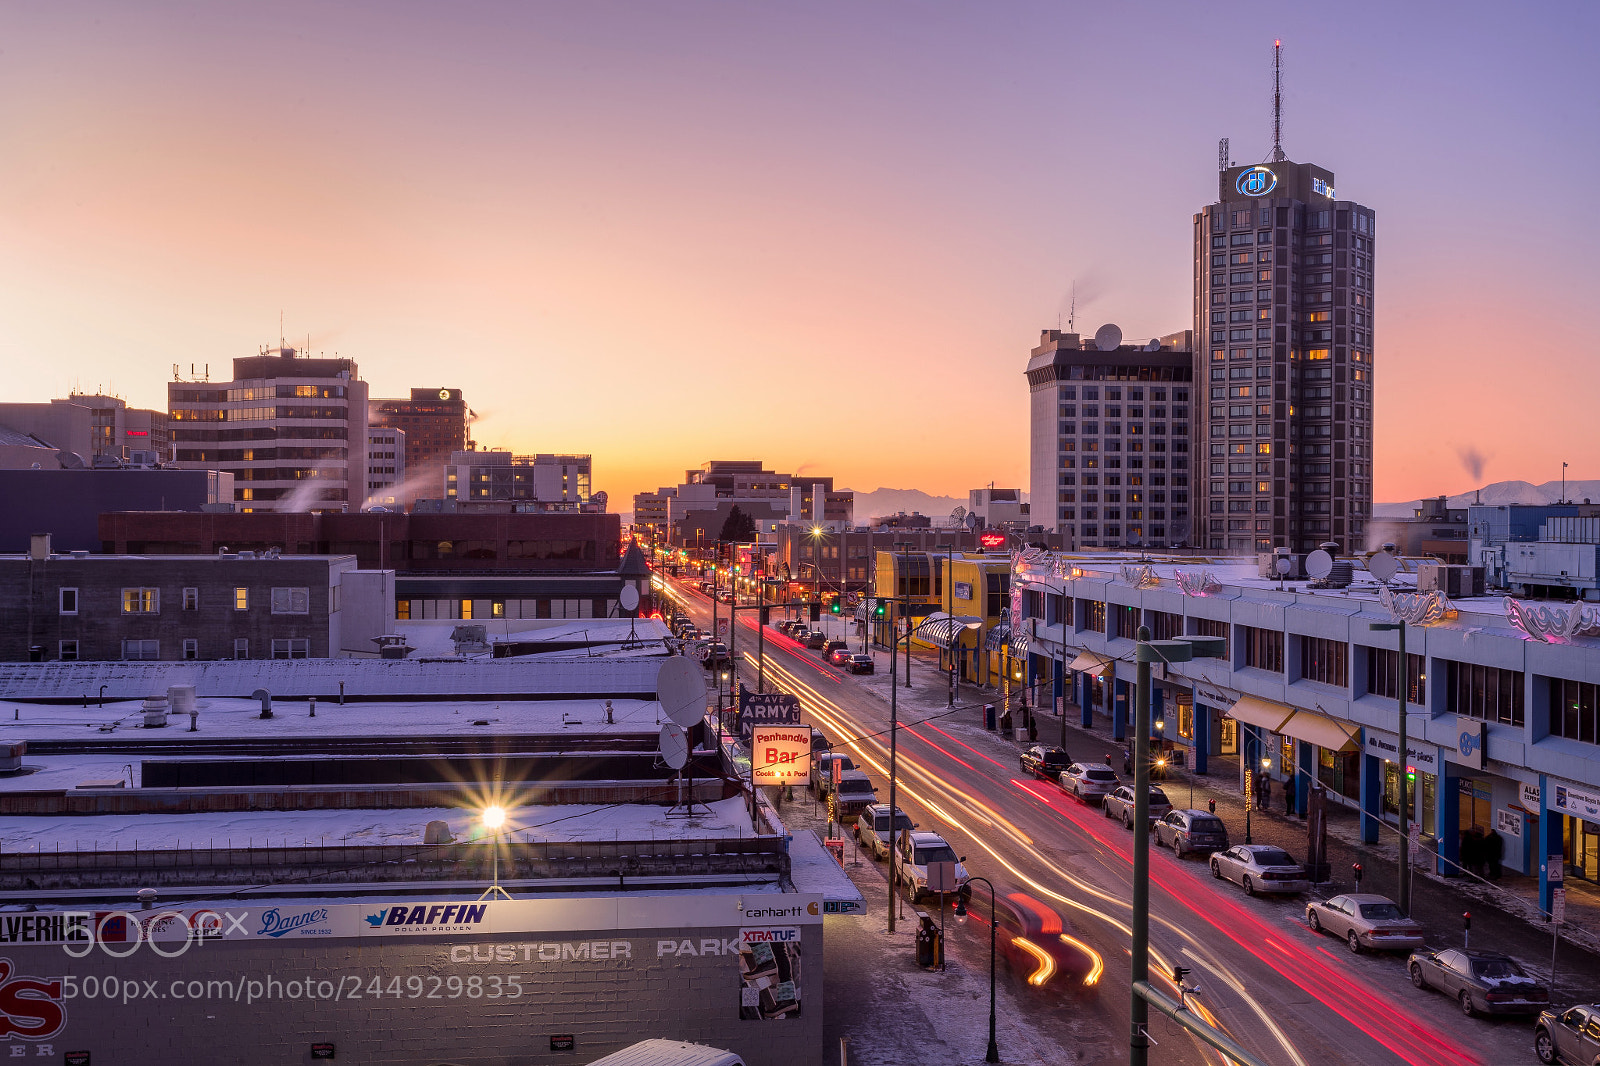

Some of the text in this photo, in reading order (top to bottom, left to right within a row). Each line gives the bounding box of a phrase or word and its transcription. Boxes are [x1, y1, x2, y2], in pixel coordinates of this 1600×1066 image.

[1313, 177, 1335, 199] Hilton
[764, 695, 786, 703] AVE
[741, 705, 791, 719] ARMY
[756, 732, 809, 744] Panhandle
[765, 747, 799, 764] Bar
[386, 904, 488, 926] BAFFIN
[746, 906, 803, 918] carhartt
[256, 907, 328, 935] Danner
[743, 930, 796, 942] XTRATUF
[450, 941, 633, 964] CUSTOMER
